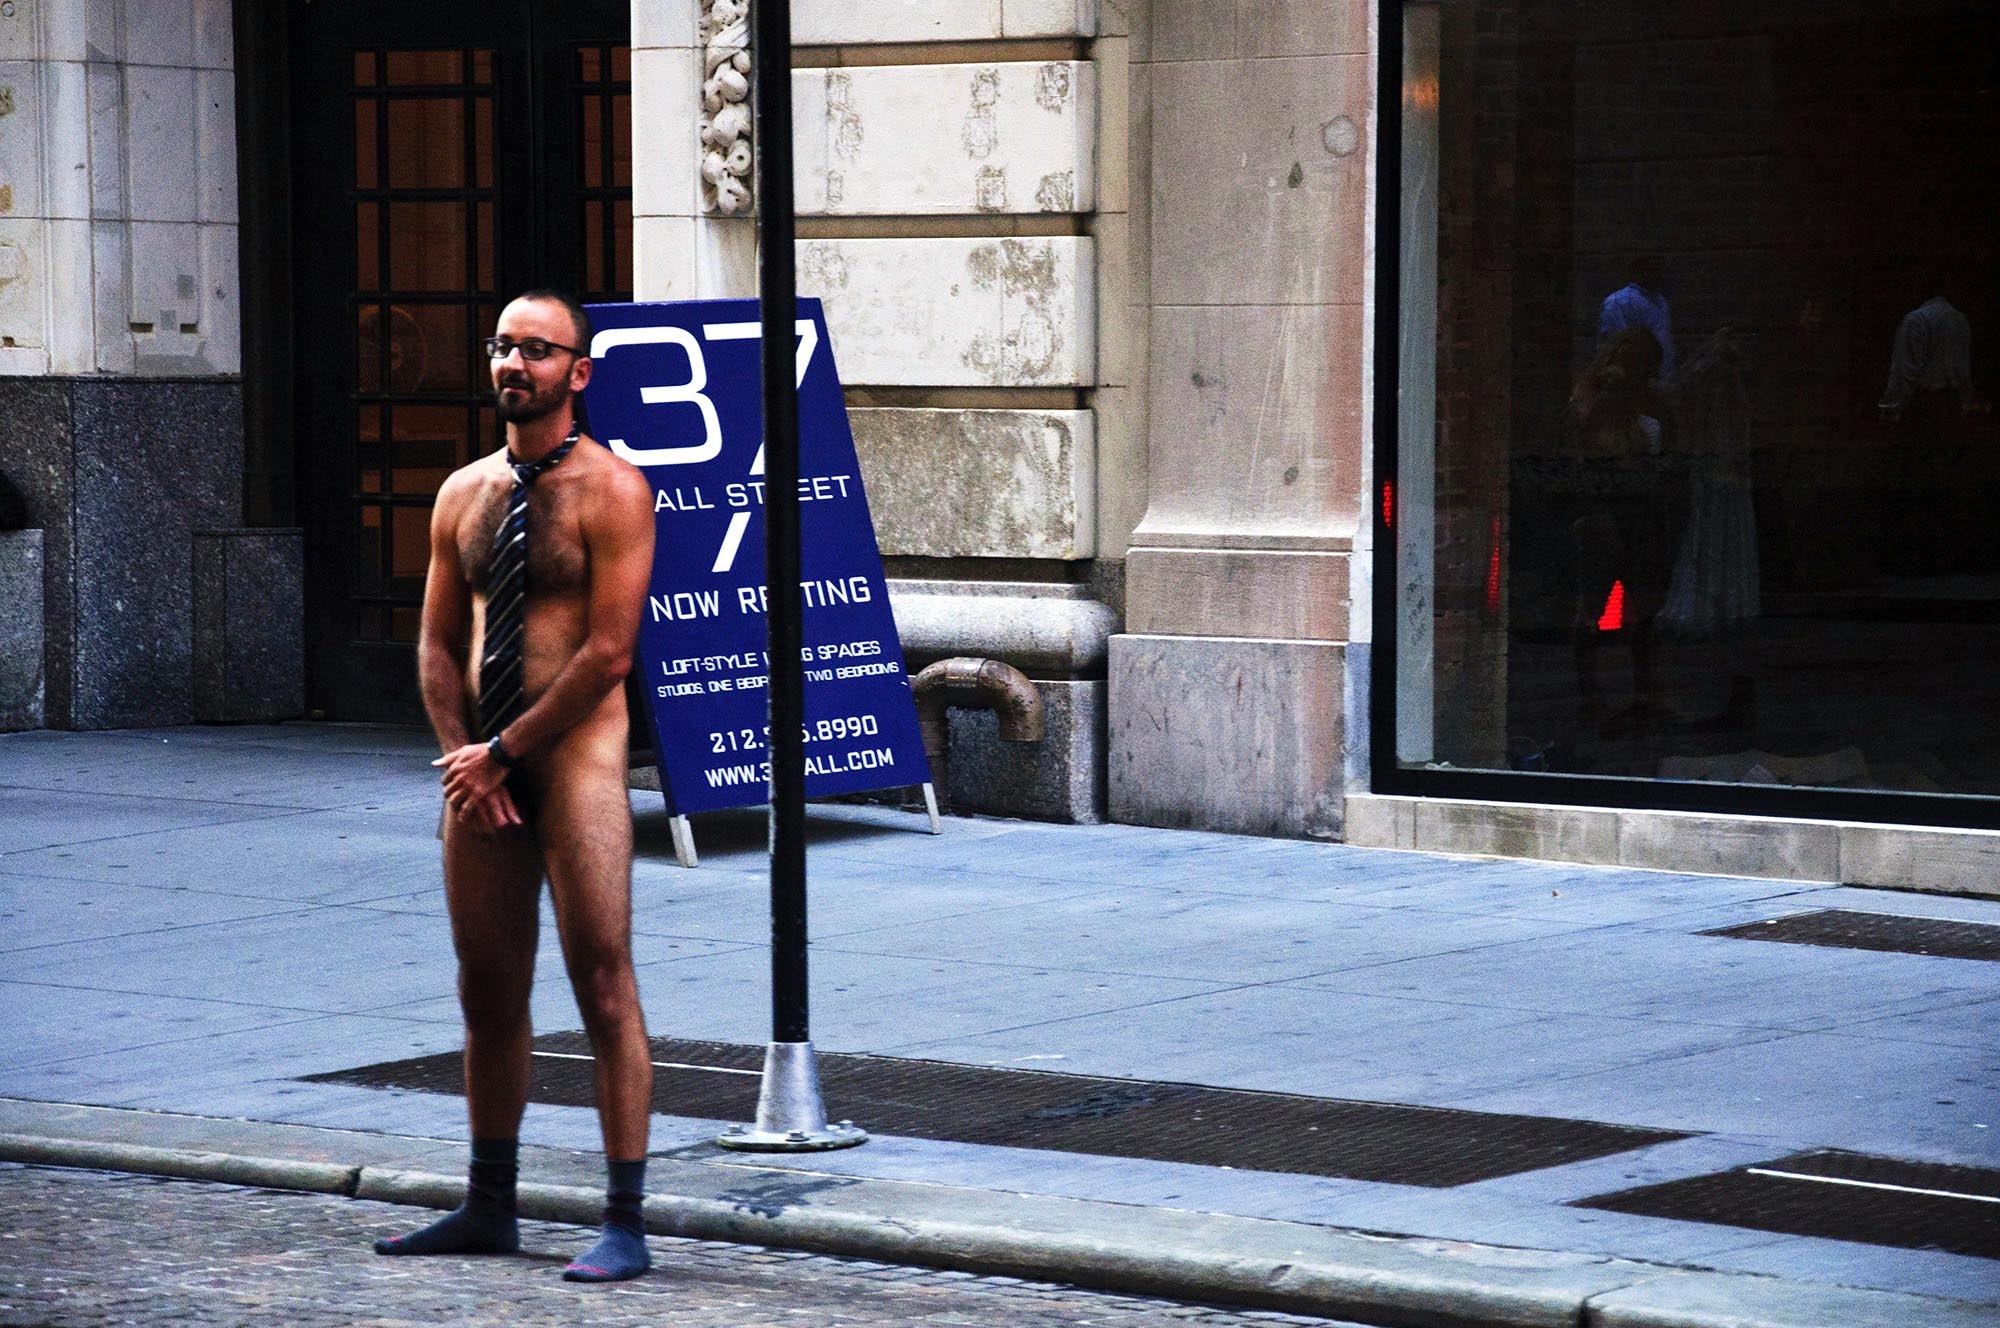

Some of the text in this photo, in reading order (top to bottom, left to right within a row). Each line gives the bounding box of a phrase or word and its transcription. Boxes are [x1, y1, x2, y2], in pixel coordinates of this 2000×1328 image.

[654, 475, 851, 512] ALL STEET
[650, 576, 871, 622] NOW RTING
[661, 652, 759, 675] LOFT-STYLE
[817, 640, 882, 660] SPACES
[708, 679, 733, 692] ONE
[804, 669, 833, 682] TWO
[836, 661, 900, 679] BEDROOMS
[709, 714, 879, 754] 212..8990
[704, 747, 895, 788] WWW.3ALL.COM
